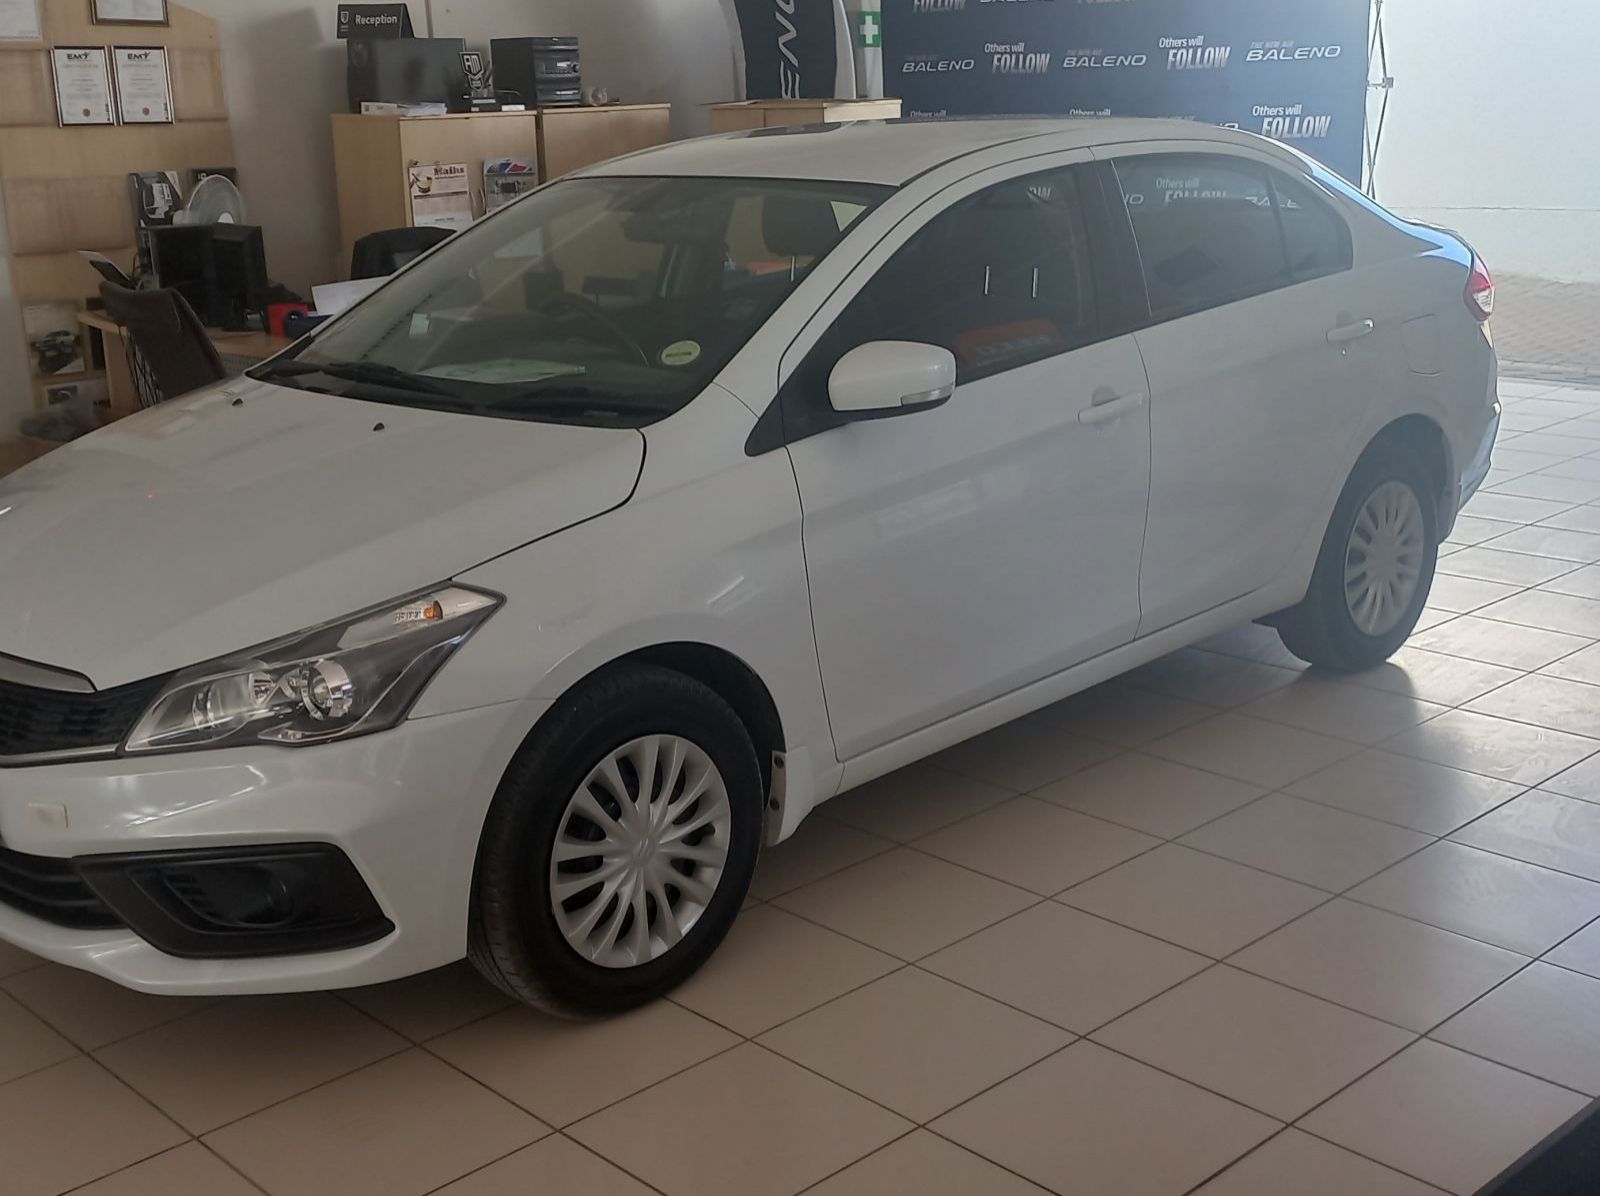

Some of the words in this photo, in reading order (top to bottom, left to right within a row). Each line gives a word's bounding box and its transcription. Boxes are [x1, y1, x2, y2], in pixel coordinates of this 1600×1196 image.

[355, 14, 398, 27] Reception
[984, 42, 1010, 53] Others
[1011, 42, 1025, 52] will
[1158, 37, 1187, 48] Others
[1188, 35, 1204, 47] will
[1167, 46, 1230, 70] FOLLOW
[1246, 46, 1341, 61] BALENO
[902, 59, 975, 73] BALENO
[992, 53, 1050, 74] FOLLOW
[1063, 55, 1147, 68] BALENO
[1252, 105, 1285, 116] Others
[1285, 104, 1302, 115] will
[1261, 116, 1331, 139] FOLLOW
